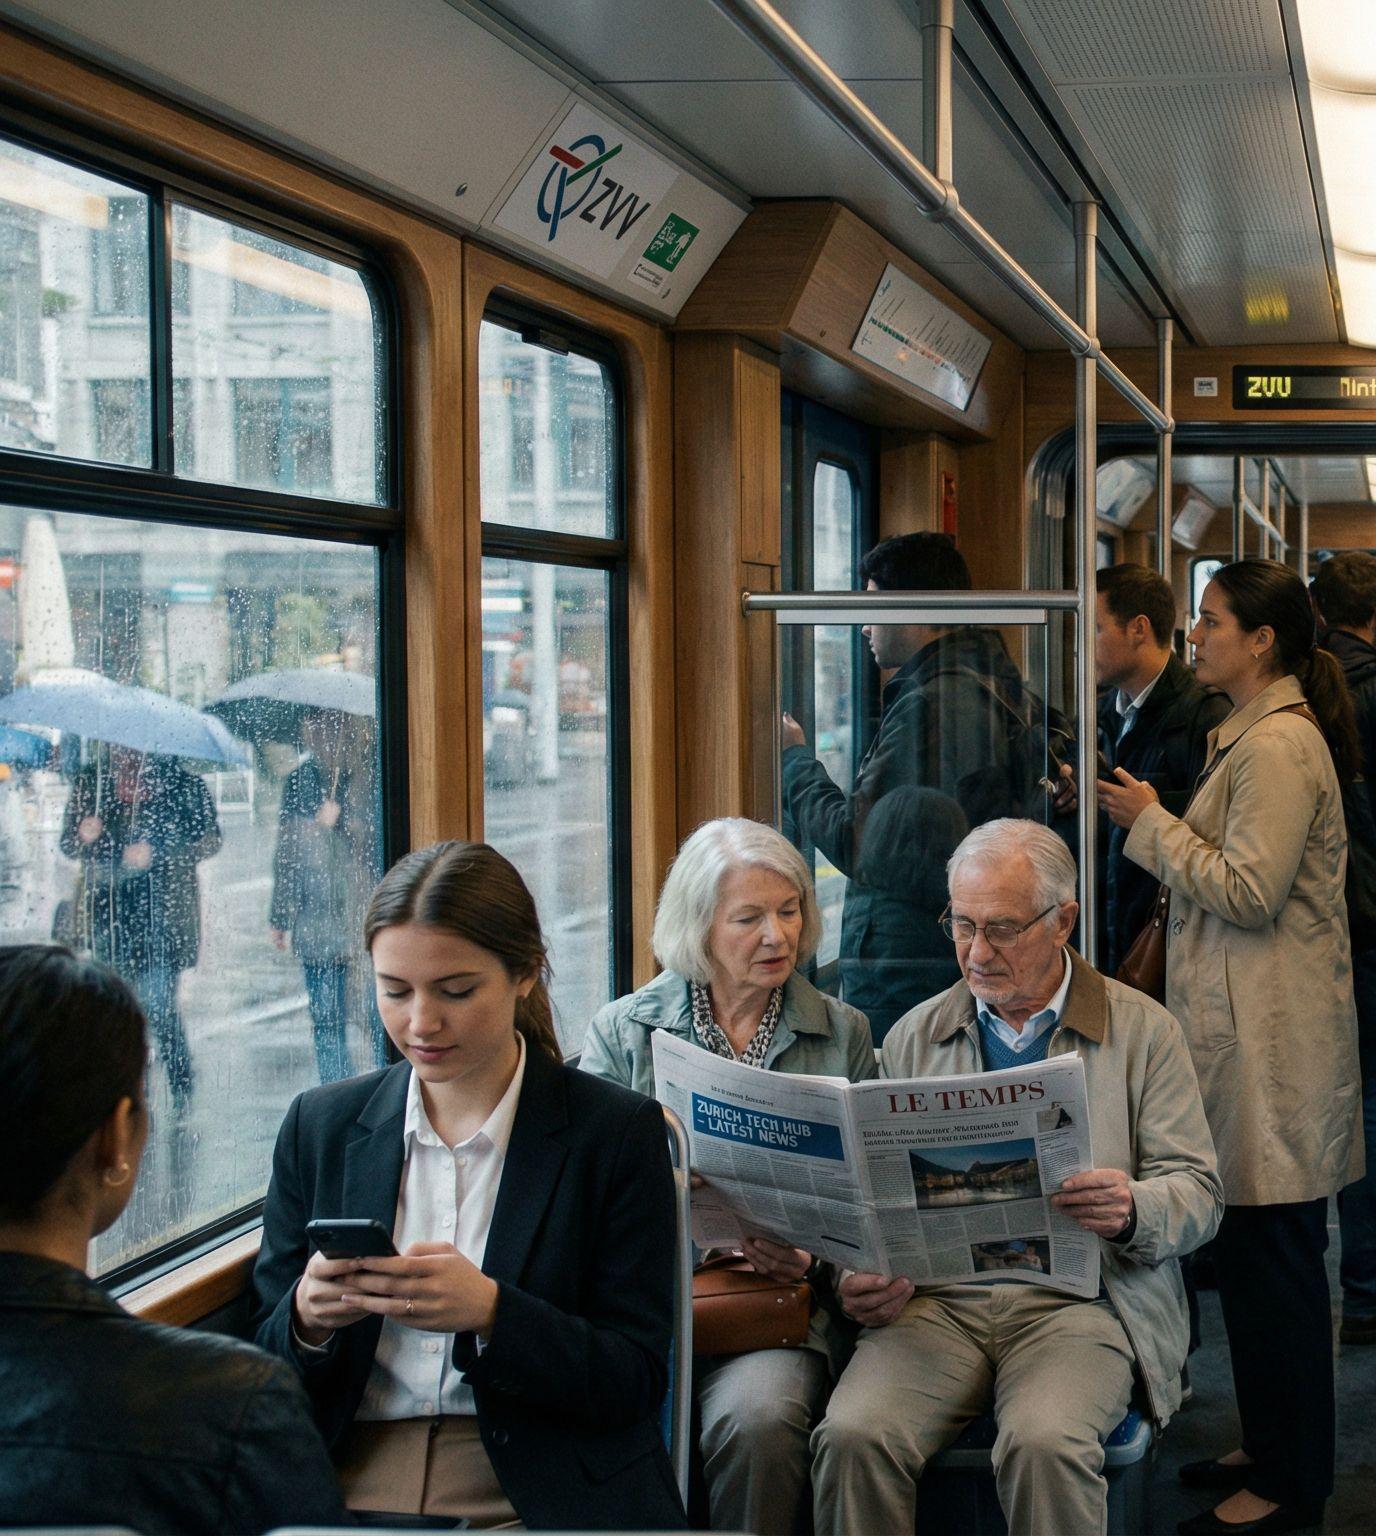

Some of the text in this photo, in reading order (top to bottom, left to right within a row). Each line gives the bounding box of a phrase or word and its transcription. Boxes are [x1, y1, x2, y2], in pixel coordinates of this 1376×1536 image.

[579, 177, 652, 241] ZVV
[887, 1080, 1046, 1114] LE TEMPS
[697, 1099, 742, 1124] ZURICH
[783, 1121, 812, 1137] HUB
[708, 1117, 753, 1140] LATEST
[758, 1130, 799, 1148] NEWS
